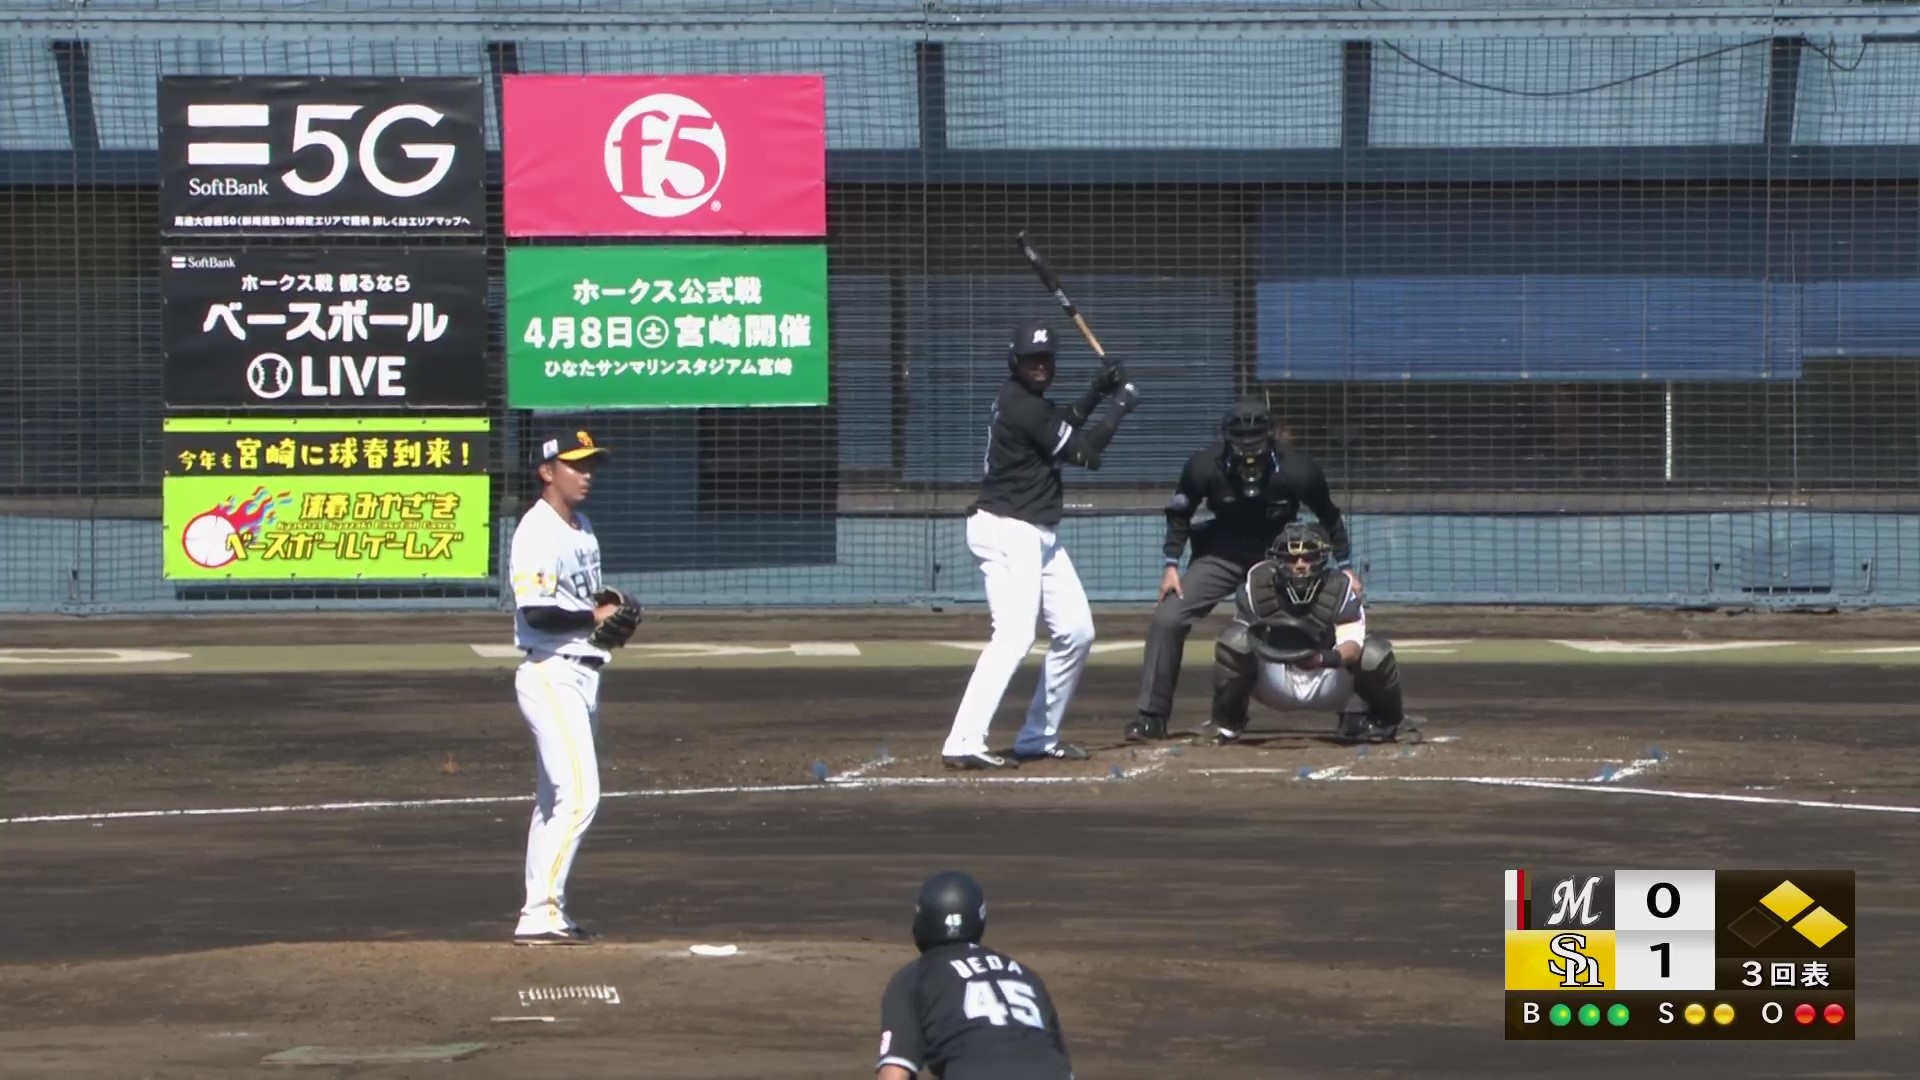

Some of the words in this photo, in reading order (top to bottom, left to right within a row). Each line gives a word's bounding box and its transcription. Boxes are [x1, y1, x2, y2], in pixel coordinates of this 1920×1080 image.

[281, 104, 456, 197] 5G
[612, 110, 721, 199] f5
[188, 177, 270, 196] SoftBank
[187, 256, 236, 269] SoftBank
[241, 274, 333, 292] ホークス戦
[339, 274, 411, 292] 観るなら
[573, 276, 763, 305] ホークス公式戦
[202, 299, 449, 342] ベースボール
[301, 355, 406, 397] LIVE
[544, 358, 793, 377] ひなたサンマリンスタジアム宮崎
[944, 912, 962, 927] 45
[963, 978, 1046, 1032] 45
